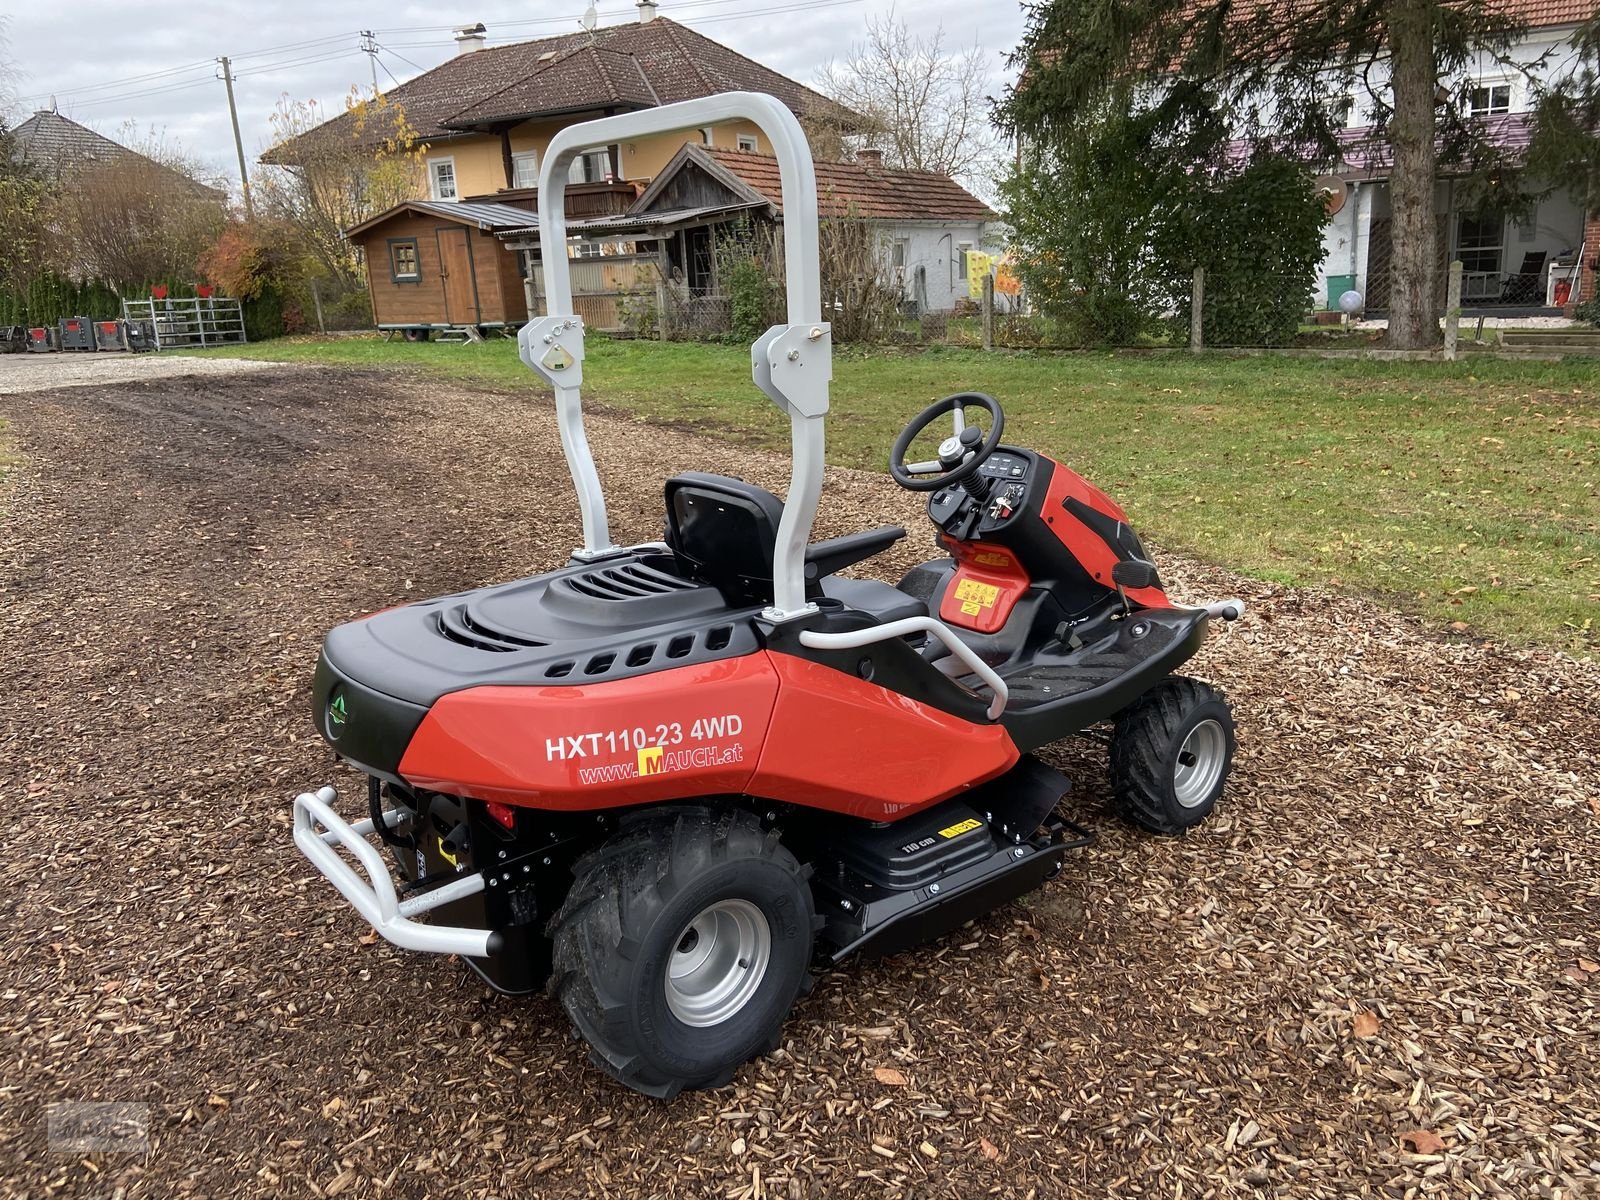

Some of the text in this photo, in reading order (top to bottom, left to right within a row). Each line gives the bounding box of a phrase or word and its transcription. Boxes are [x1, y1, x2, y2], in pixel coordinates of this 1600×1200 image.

[546, 715, 742, 760] HXT110-23 4WD
[902, 837, 936, 853] 110 cm
